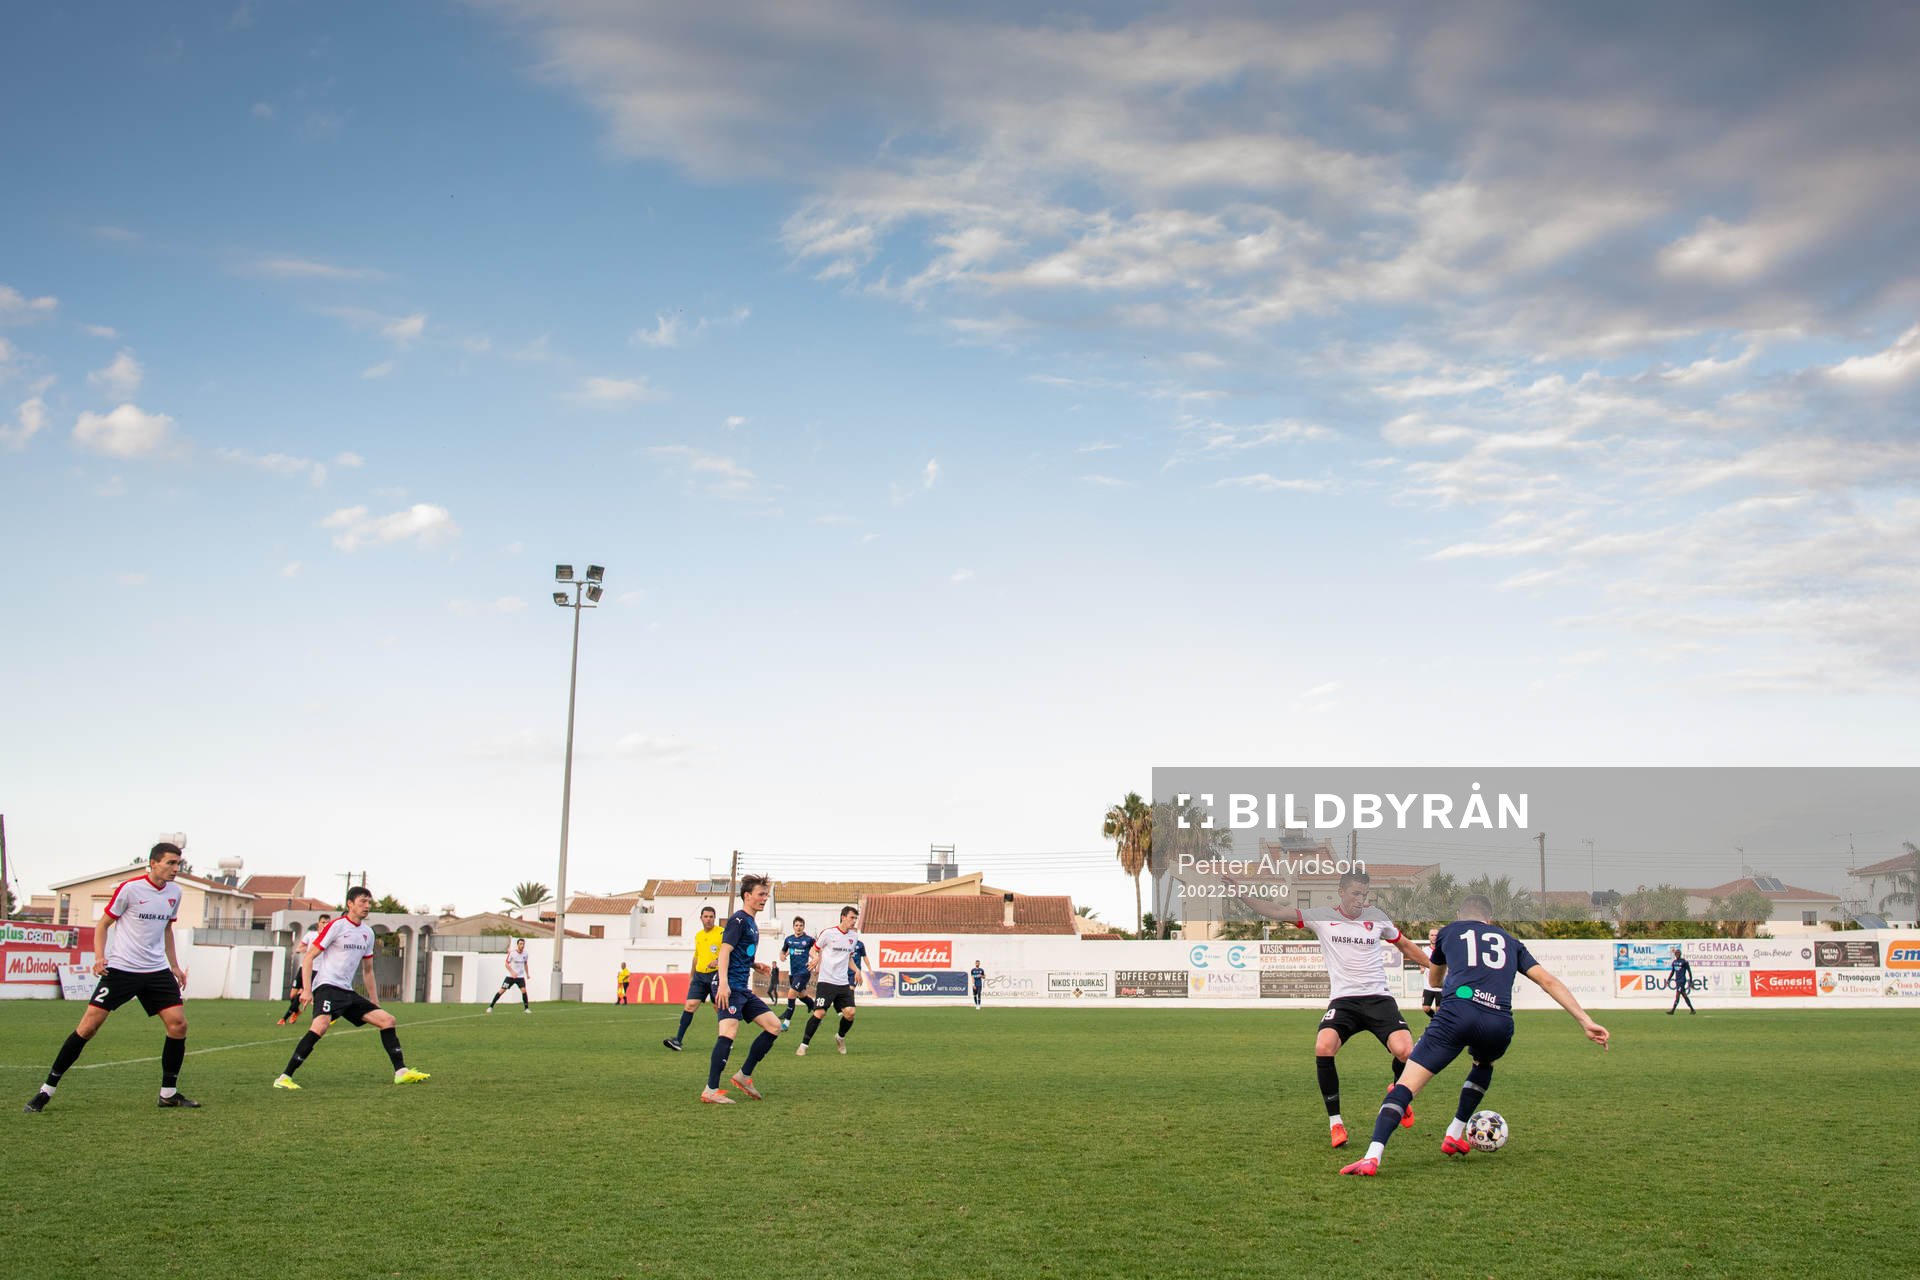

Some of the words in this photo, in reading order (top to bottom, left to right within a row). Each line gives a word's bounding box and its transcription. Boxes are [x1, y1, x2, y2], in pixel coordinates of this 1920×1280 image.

[1262, 944, 1284, 954] VASOS
[1459, 929, 1507, 970] 13
[1699, 943, 1744, 952] GEMABA
[1115, 972, 1148, 981] COFFEE
[1157, 972, 1188, 981] SWEET
[1769, 977, 1813, 986] Genesis
[901, 982, 933, 992] Dulux
[95, 987, 109, 1003] 2
[1473, 989, 1497, 1004] Solid
[322, 1000, 331, 1012] 5
[816, 998, 825, 1006] 18
